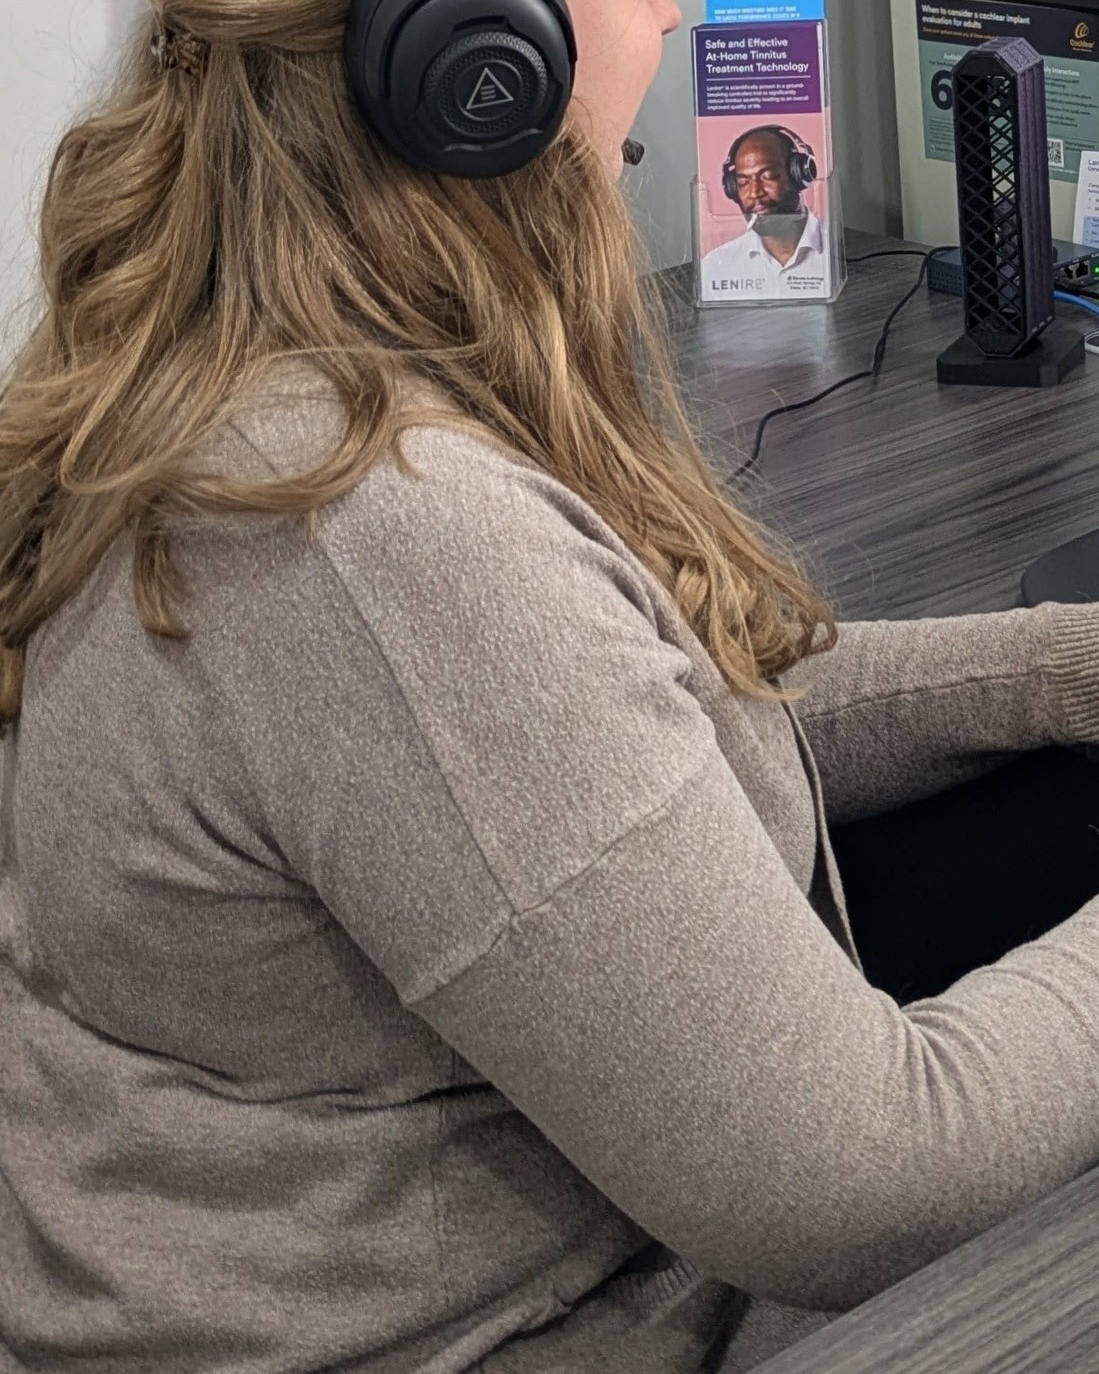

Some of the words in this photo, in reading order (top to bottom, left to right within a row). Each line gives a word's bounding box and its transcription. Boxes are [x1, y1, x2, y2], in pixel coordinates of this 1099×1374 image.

[921, 4, 940, 13] When
[948, 8, 973, 18] consider
[979, 12, 1005, 22] cochlear
[1006, 14, 1030, 25] implant
[922, 16, 952, 26] evaluation
[953, 18, 962, 26] for
[963, 20, 982, 28] adults
[705, 39, 726, 49] Safe
[728, 39, 745, 48] and
[747, 37, 788, 47] Effective
[1070, 39, 1094, 48] Cochlear
[706, 52, 748, 61] At-Home
[750, 50, 786, 59] Tinnitus
[706, 64, 753, 73] Treatment
[756, 62, 809, 73] Technology
